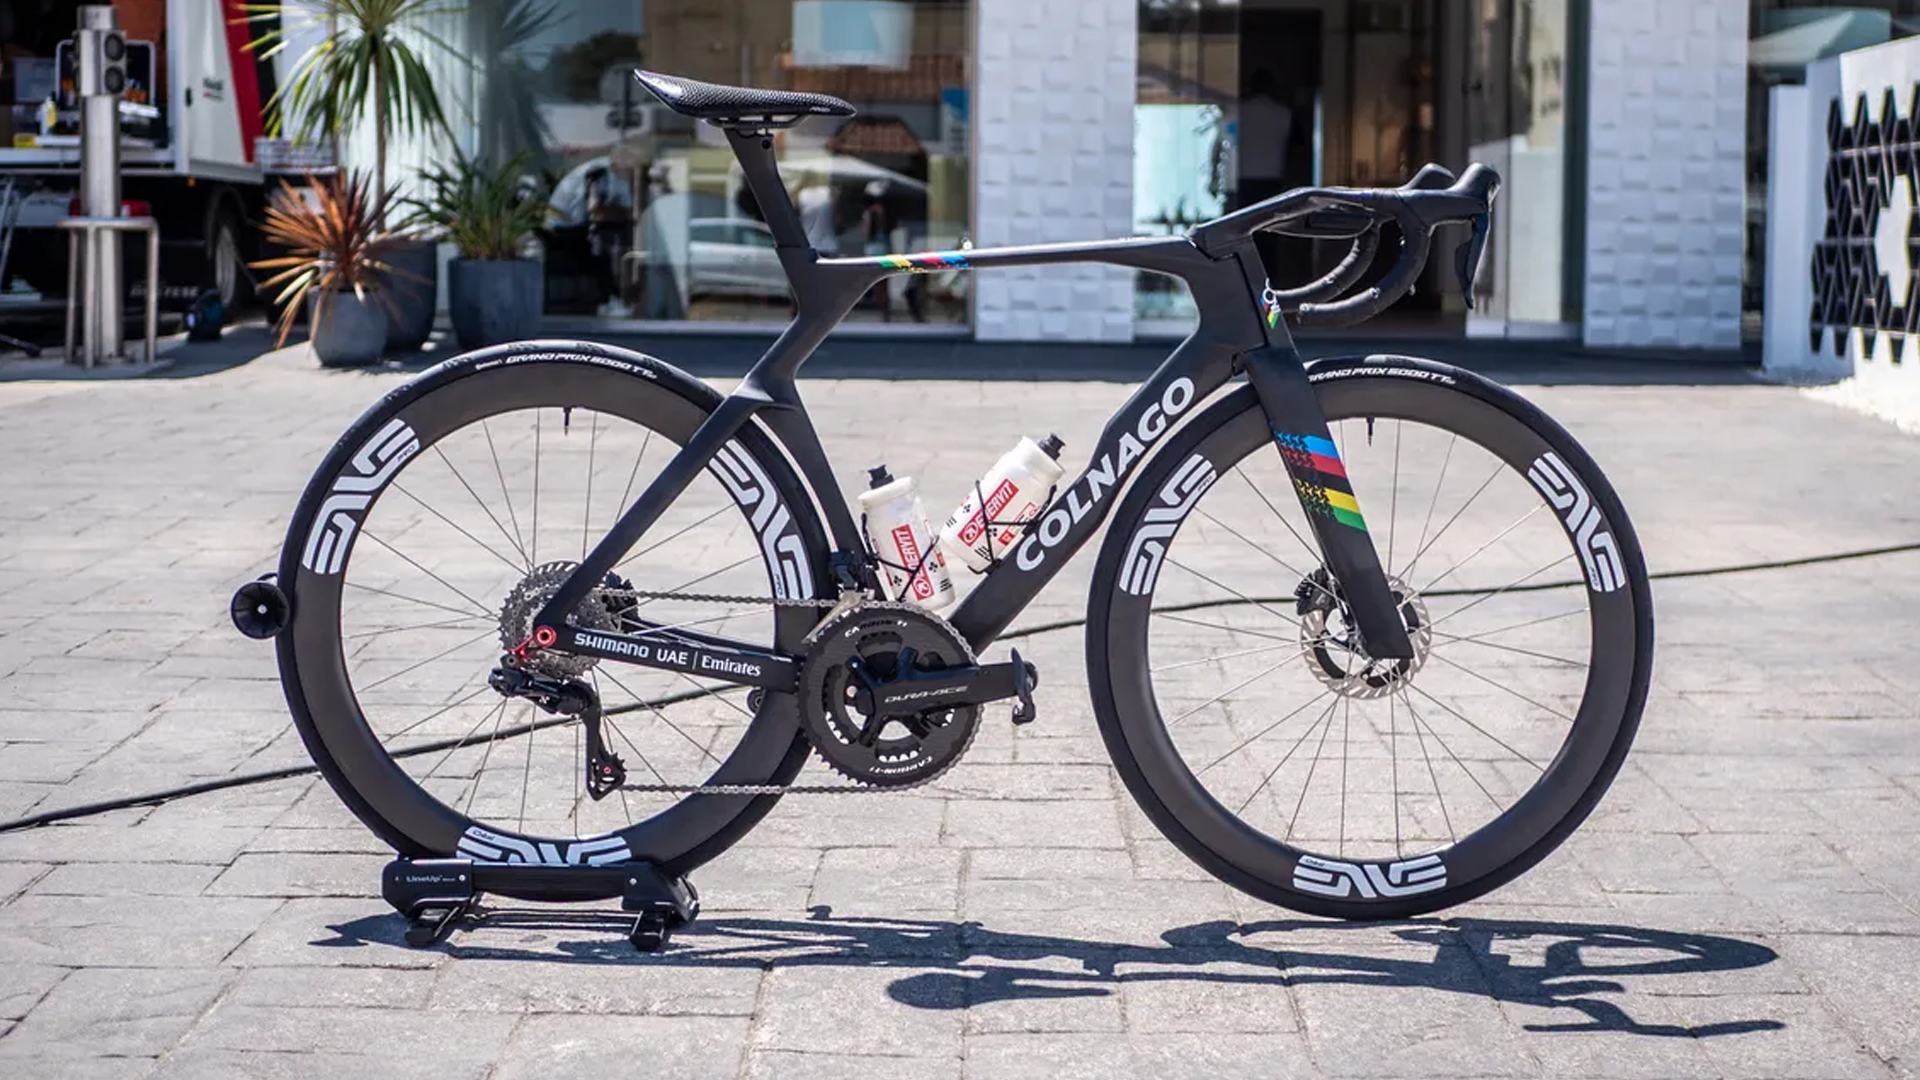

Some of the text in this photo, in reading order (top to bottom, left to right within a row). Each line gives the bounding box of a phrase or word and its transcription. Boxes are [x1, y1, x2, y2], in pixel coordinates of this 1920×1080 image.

[505, 353, 554, 364] GRAND
[555, 352, 592, 362] PRIX
[1351, 367, 1389, 376] PRIX
[1386, 368, 1430, 379] 5000
[302, 418, 420, 574] ENVE
[1016, 377, 1195, 571] COLNAGO
[709, 439, 814, 601] ENVE
[1119, 453, 1217, 596] ENVE
[1527, 452, 1626, 592] ENVE
[574, 632, 649, 658] SHIMANO
[656, 648, 761, 677] UAE Emirates
[885, 685, 968, 703] DURA-ACE
[1292, 854, 1447, 898] ENVE
